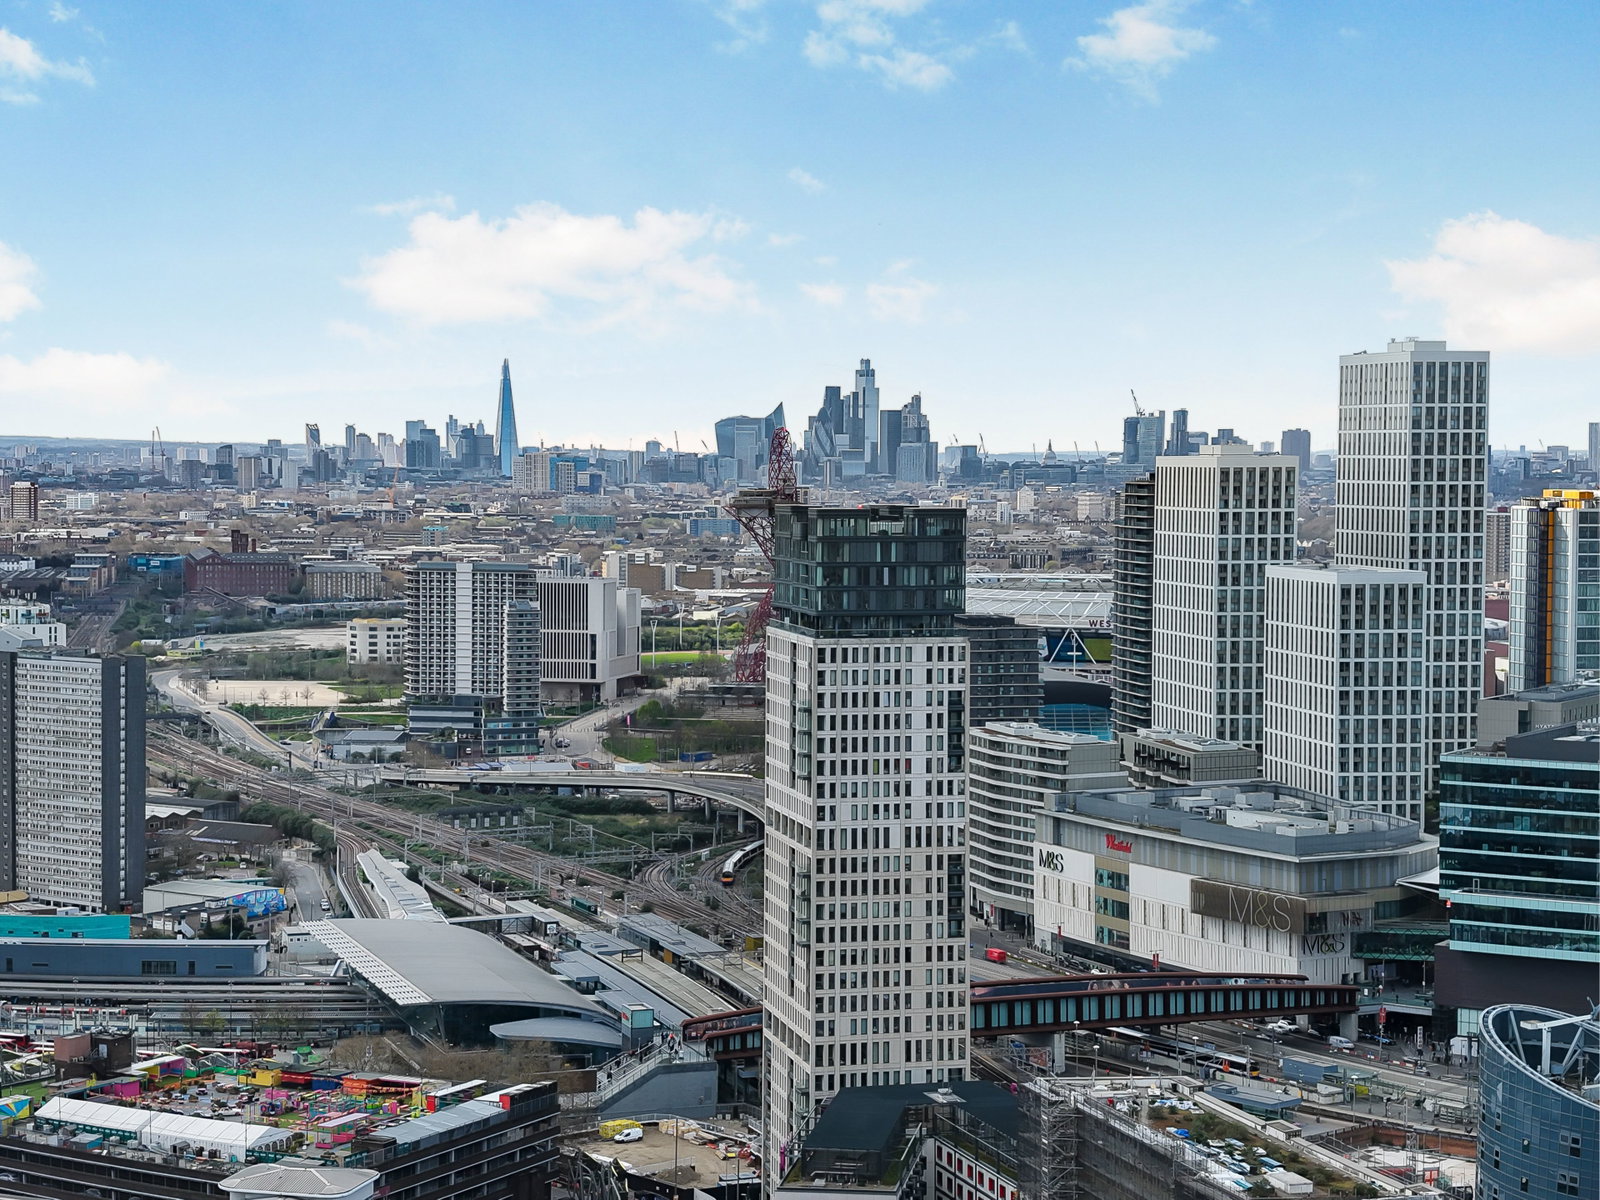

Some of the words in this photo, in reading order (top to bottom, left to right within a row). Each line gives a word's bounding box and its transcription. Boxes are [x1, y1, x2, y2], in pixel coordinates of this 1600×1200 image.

[1038, 848, 1064, 873] M&S
[1229, 887, 1291, 932] M&S
[1302, 932, 1345, 956] M&S
